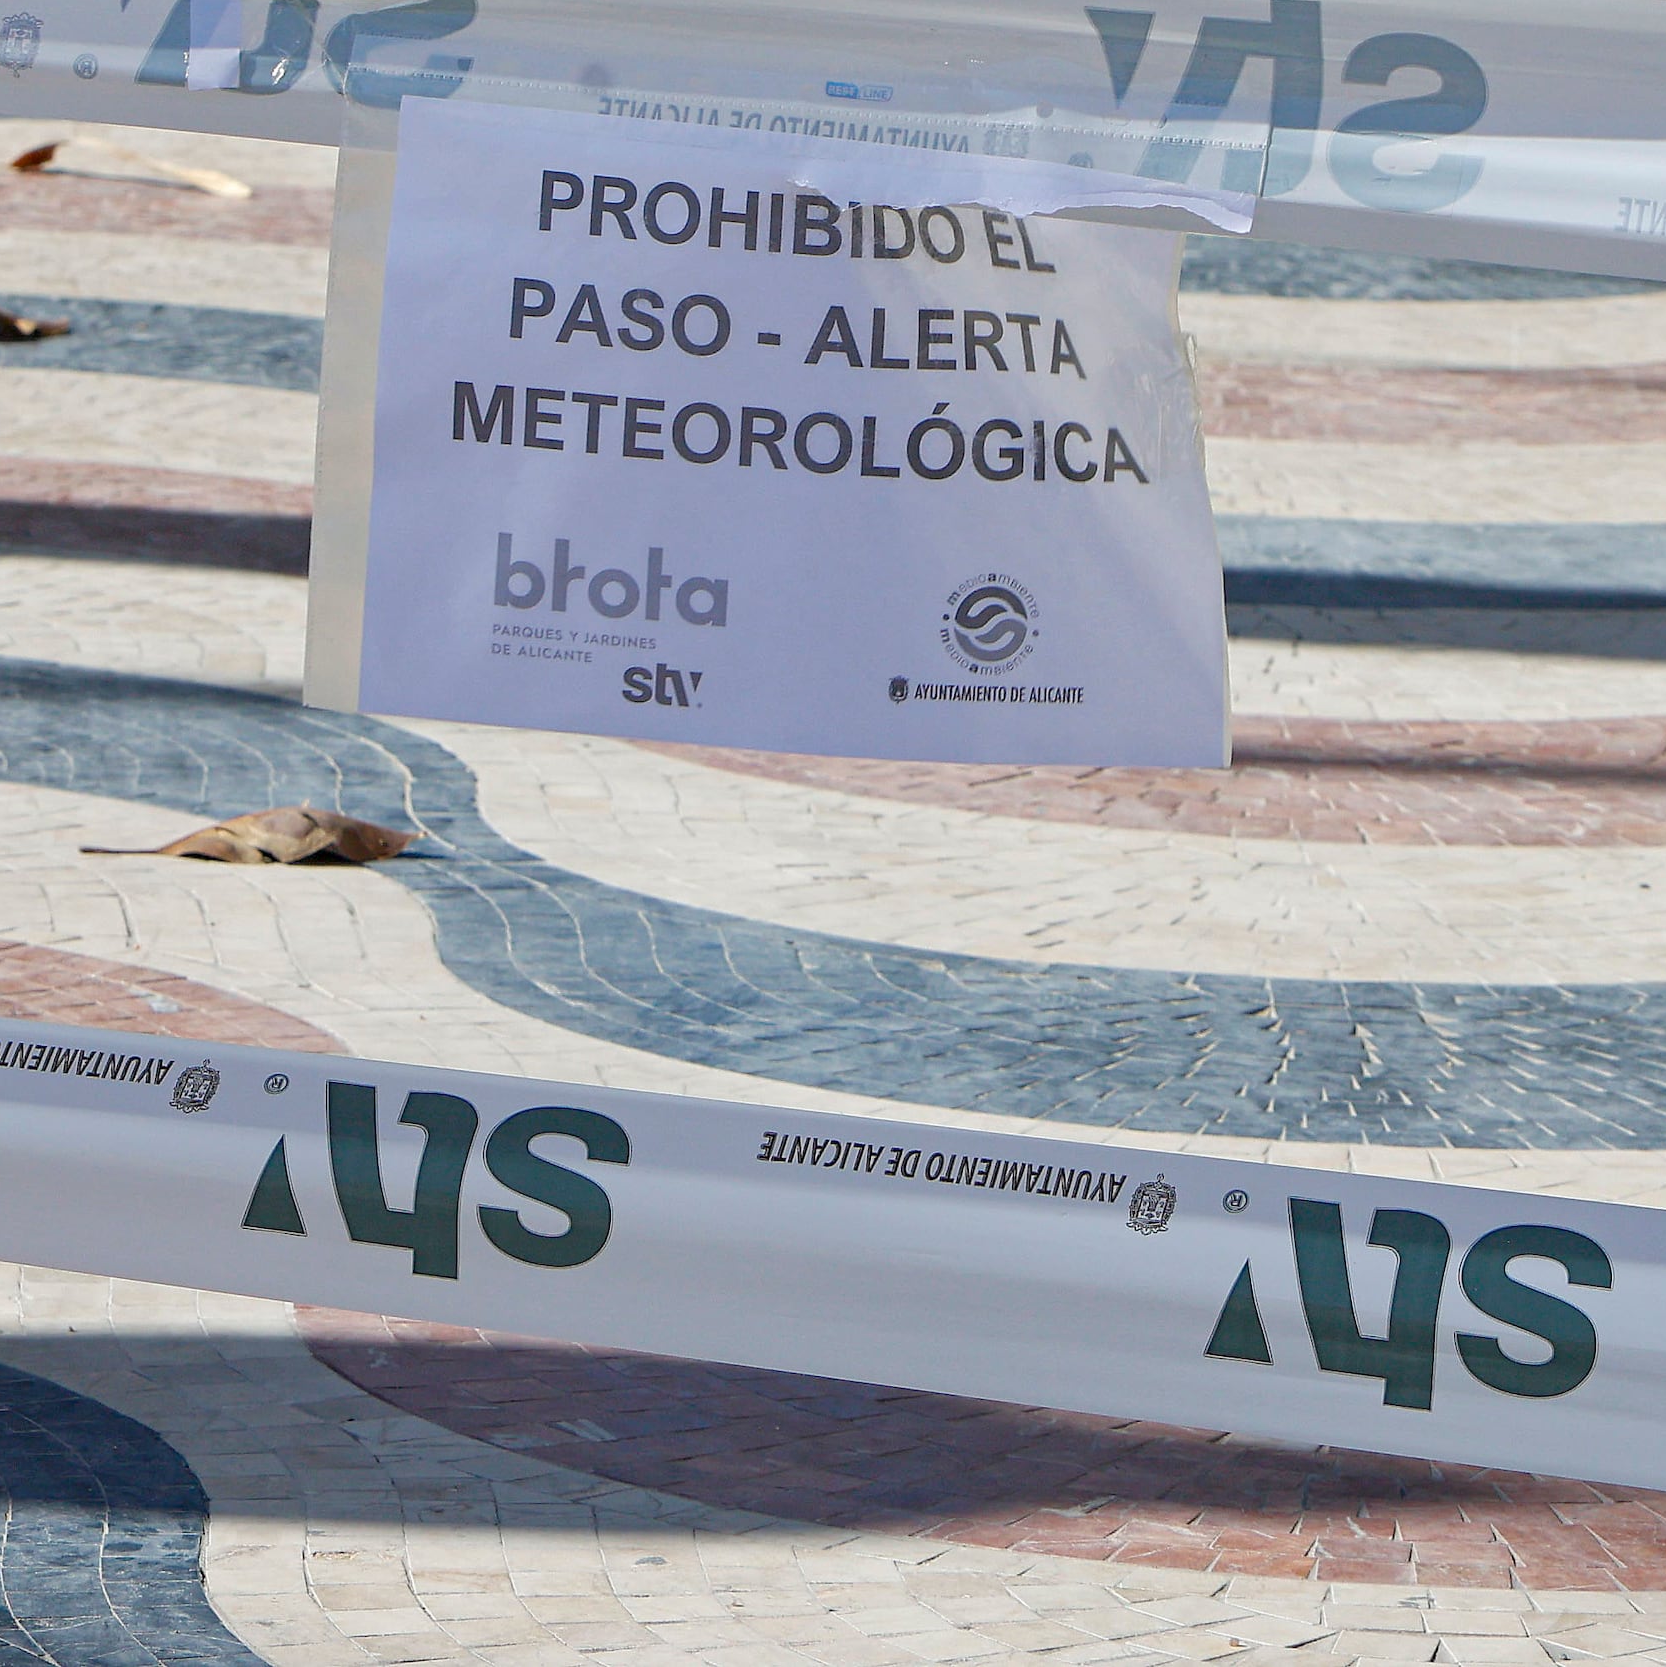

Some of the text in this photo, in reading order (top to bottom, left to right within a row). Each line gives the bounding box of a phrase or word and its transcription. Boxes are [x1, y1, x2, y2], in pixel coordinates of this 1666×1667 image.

[538, 169, 1057, 274] PROHIBIDO EL
[509, 277, 731, 357] PASO
[804, 304, 1087, 380] ALERTA
[452, 380, 1150, 485] METEOROLÓGICA
[494, 532, 729, 627] brota
[491, 643, 593, 663] DE ALICANTE
[492, 624, 657, 650] PARQUES Y JARDINES
[914, 684, 1084, 704] AYUNTAMIENTO DE ALICANTE
[756, 1131, 1127, 1203] AYUNTAMIENTO DE ALICANTE
